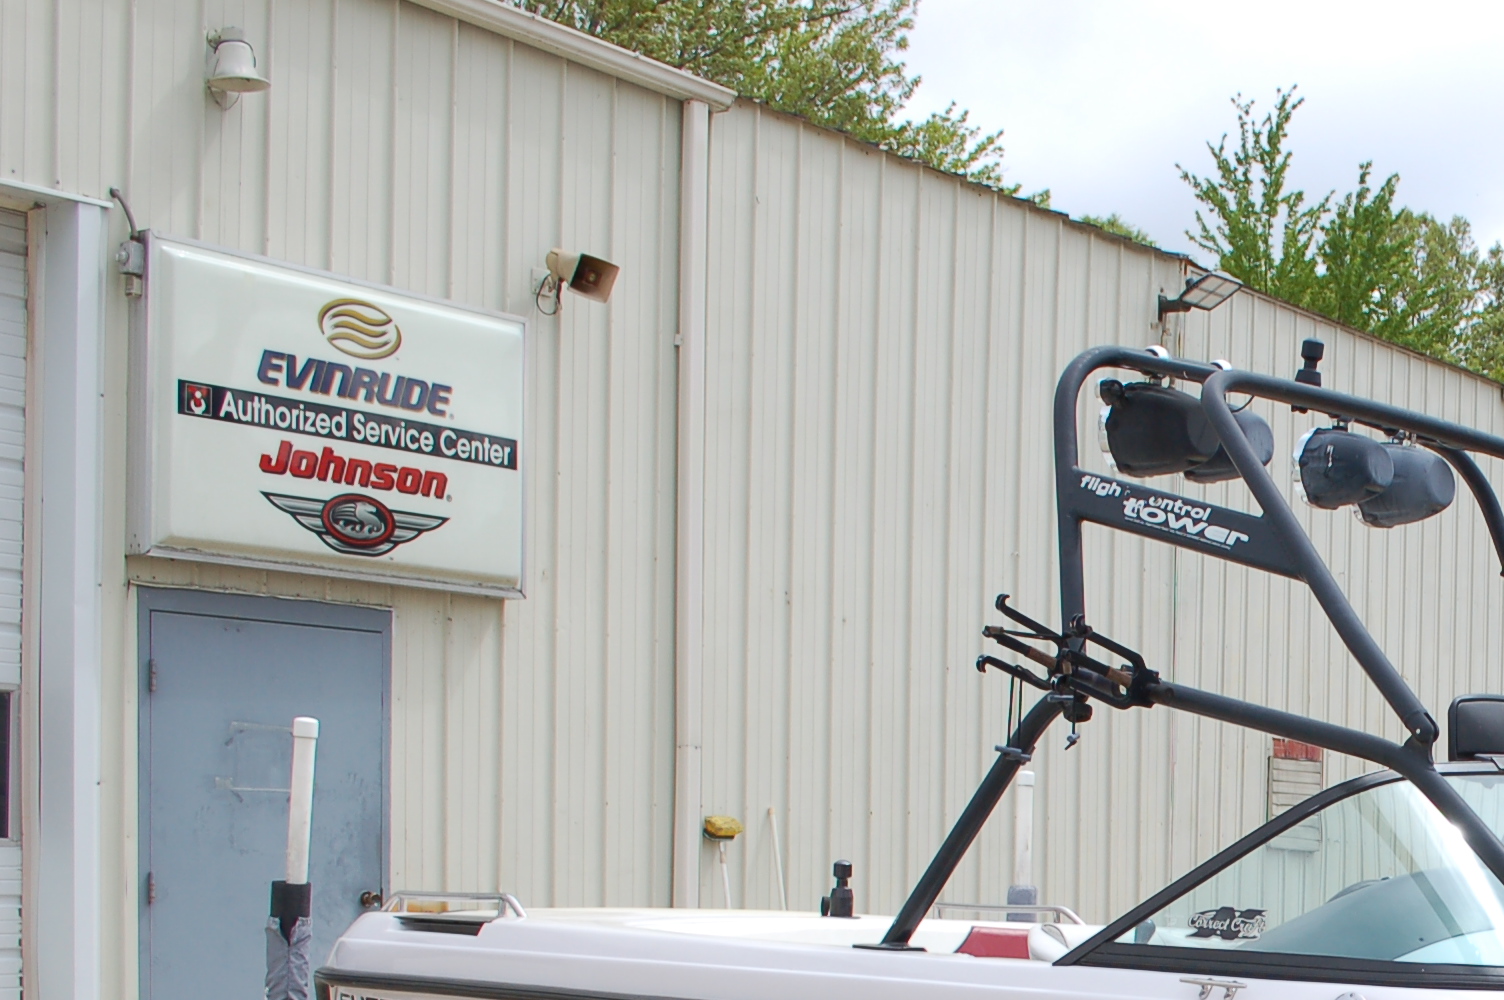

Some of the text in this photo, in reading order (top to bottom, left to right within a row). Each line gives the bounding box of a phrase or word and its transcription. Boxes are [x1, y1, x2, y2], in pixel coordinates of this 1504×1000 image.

[257, 349, 453, 418] EVINRUDE
[220, 391, 512, 466] Authorized Service Center
[259, 440, 449, 500] Johnson
[1123, 497, 1249, 546] tower
